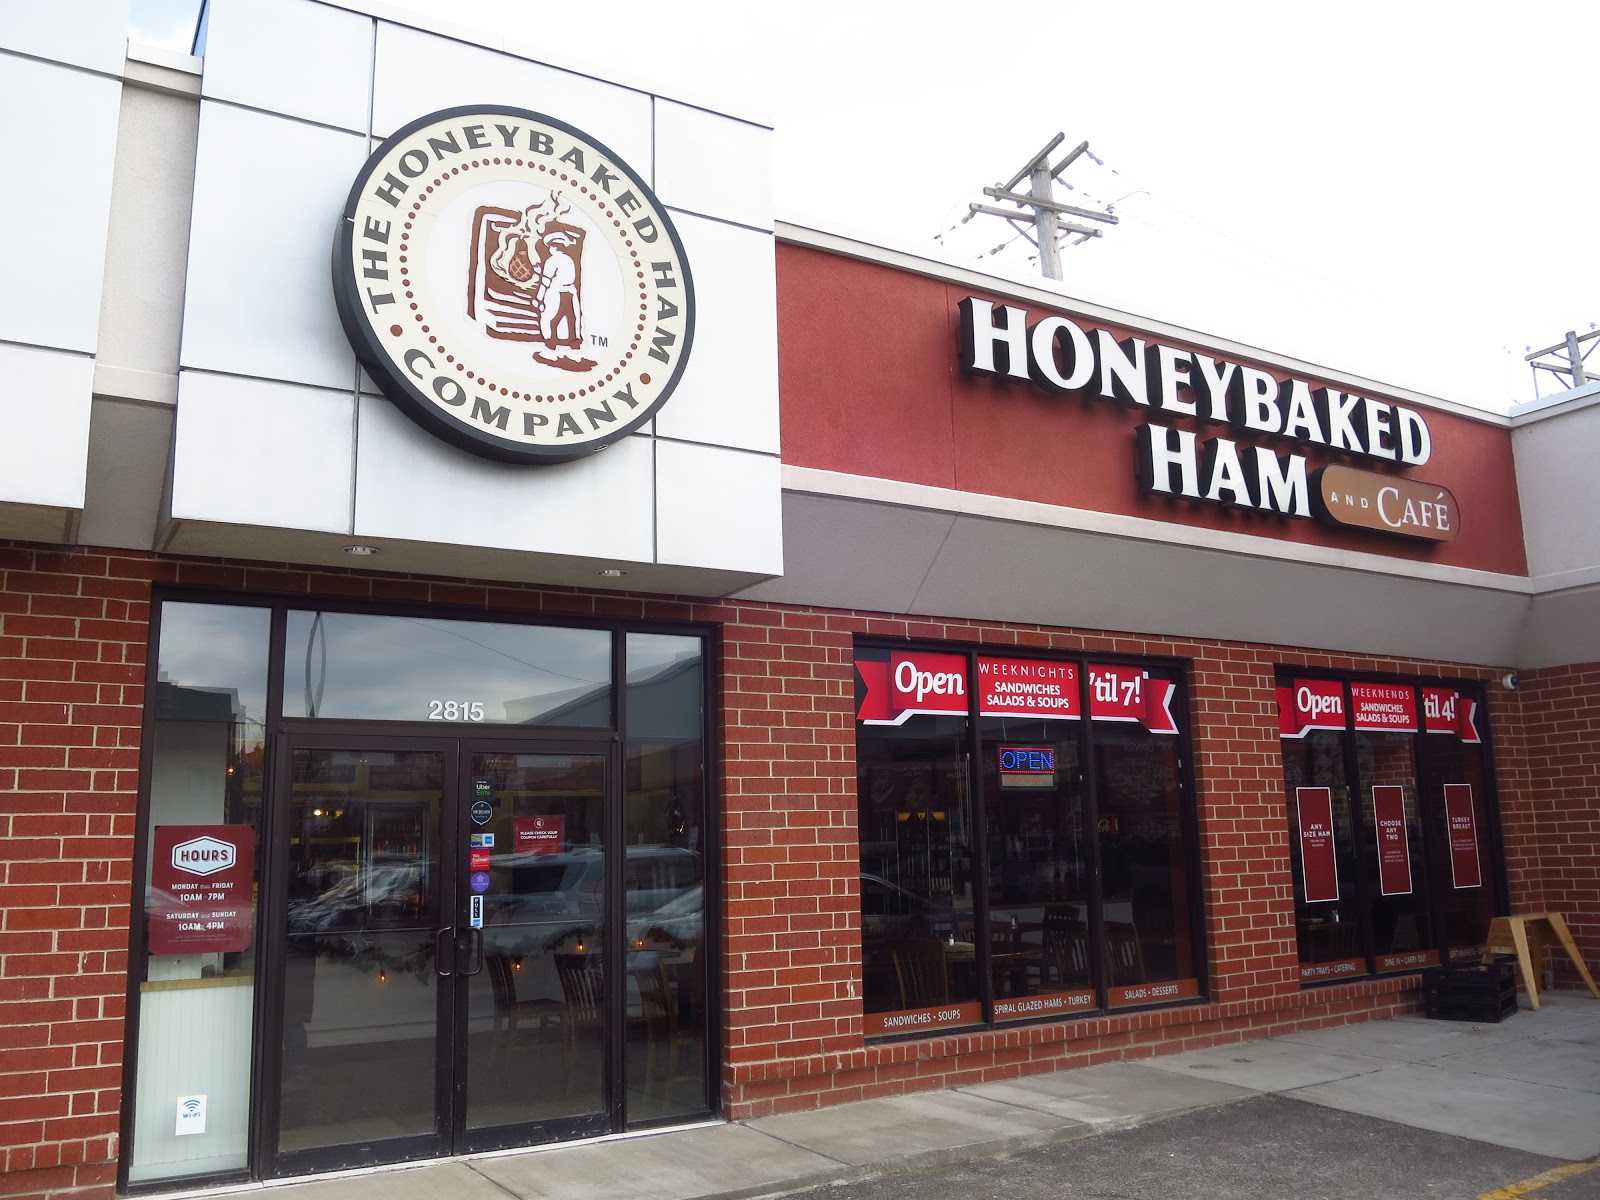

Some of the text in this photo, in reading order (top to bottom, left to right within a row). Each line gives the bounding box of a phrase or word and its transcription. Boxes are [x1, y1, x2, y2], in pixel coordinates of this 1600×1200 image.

[363, 124, 678, 437] THE HONEYBAKED HAM COMPANY
[590, 335, 608, 348] TM
[968, 296, 1432, 466] HONEYBAKED
[1148, 423, 1313, 518] HAM
[1331, 486, 1450, 531] AND CAFÉ
[978, 662, 1074, 680] WEEKNIGHTS
[895, 661, 964, 702] Open
[995, 682, 1060, 695] SANDWICHES
[1122, 677, 1141, 706] 7!
[1351, 688, 1410, 700] WEEKNENDS
[428, 700, 484, 721] 2815
[987, 695, 1069, 709] SALADS & SOUPS
[1297, 687, 1342, 719] Open
[1360, 703, 1403, 713] SANDWICHES
[1442, 698, 1455, 721] 4!
[1356, 712, 1410, 724] SALADS & SOUPS
[1002, 751, 1052, 769] OPEN
[181, 849, 229, 862] HOURS
[180, 893, 202, 901] 10AM
[178, 923, 201, 931] 10AM
[1124, 984, 1178, 999] SALADS DESSERTS
[994, 995, 1091, 1015] SPIRAL GLAZED HAMS TURKEY
[883, 1009, 961, 1028] SANDWICHES SOUPS
